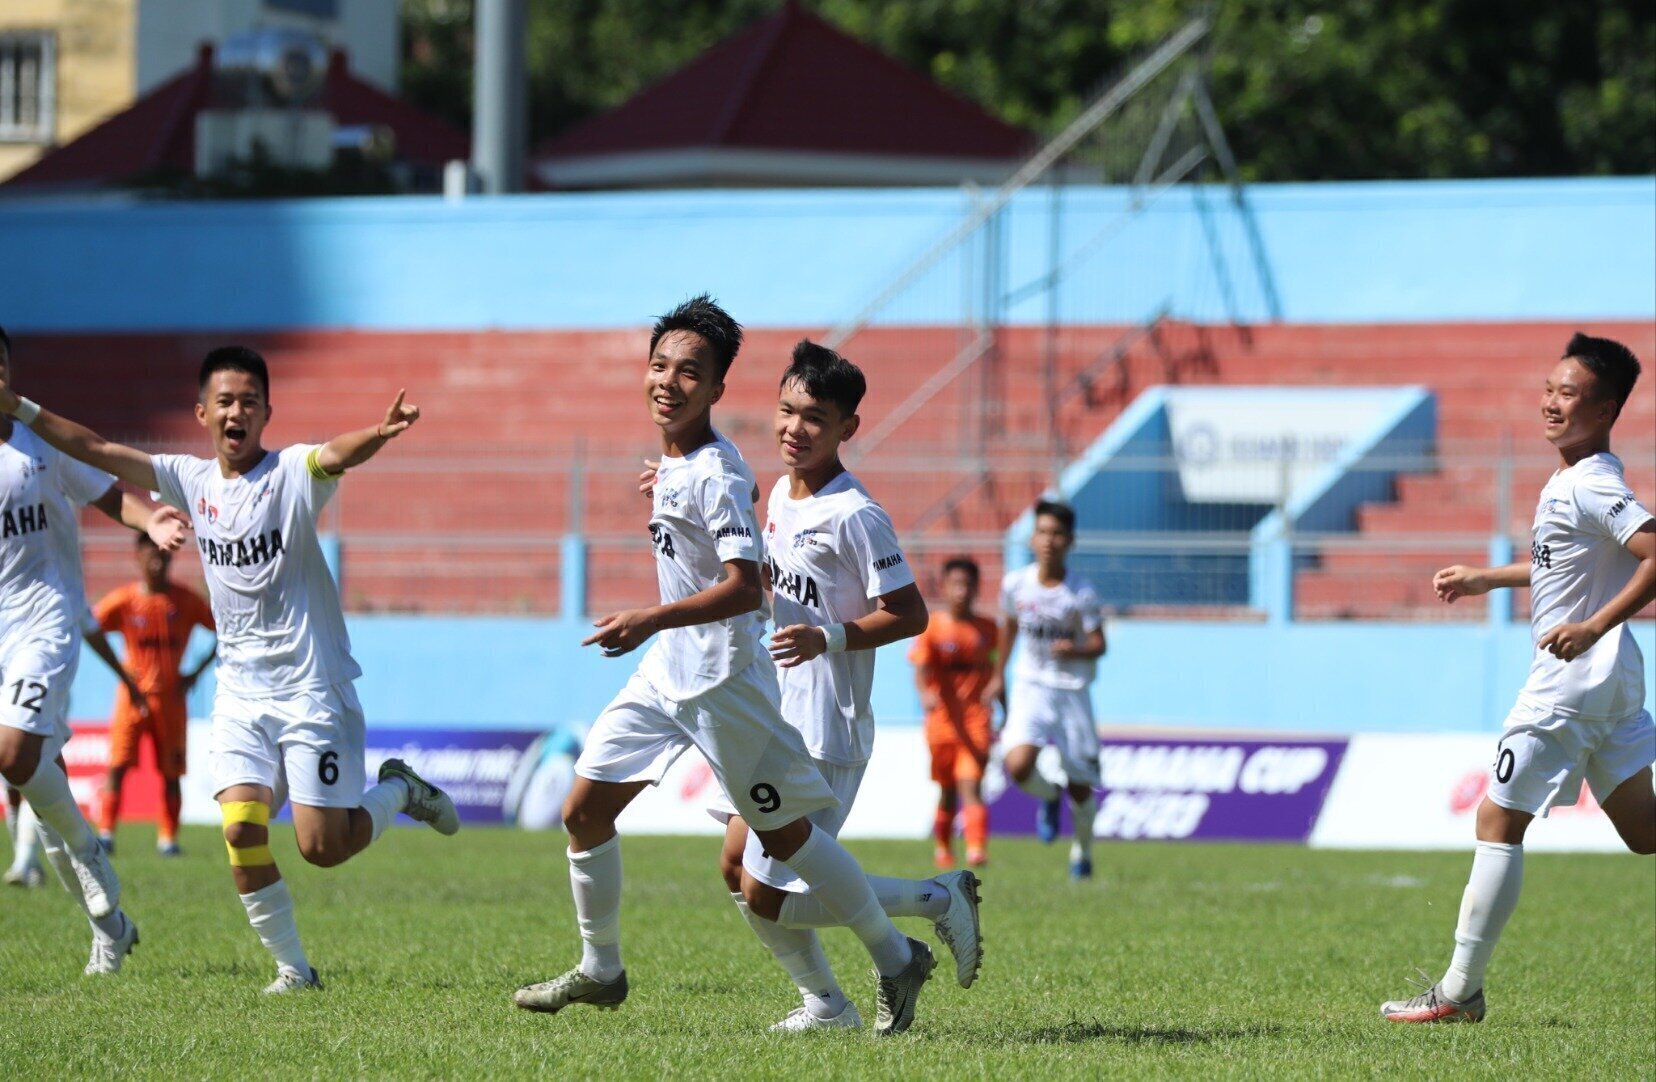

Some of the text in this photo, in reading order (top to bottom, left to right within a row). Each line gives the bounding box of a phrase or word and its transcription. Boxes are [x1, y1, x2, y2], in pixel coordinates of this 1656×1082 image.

[0, 503, 48, 538] AHA
[10, 679, 48, 713] 12
[318, 751, 339, 786] 6
[750, 782, 782, 813] 9
